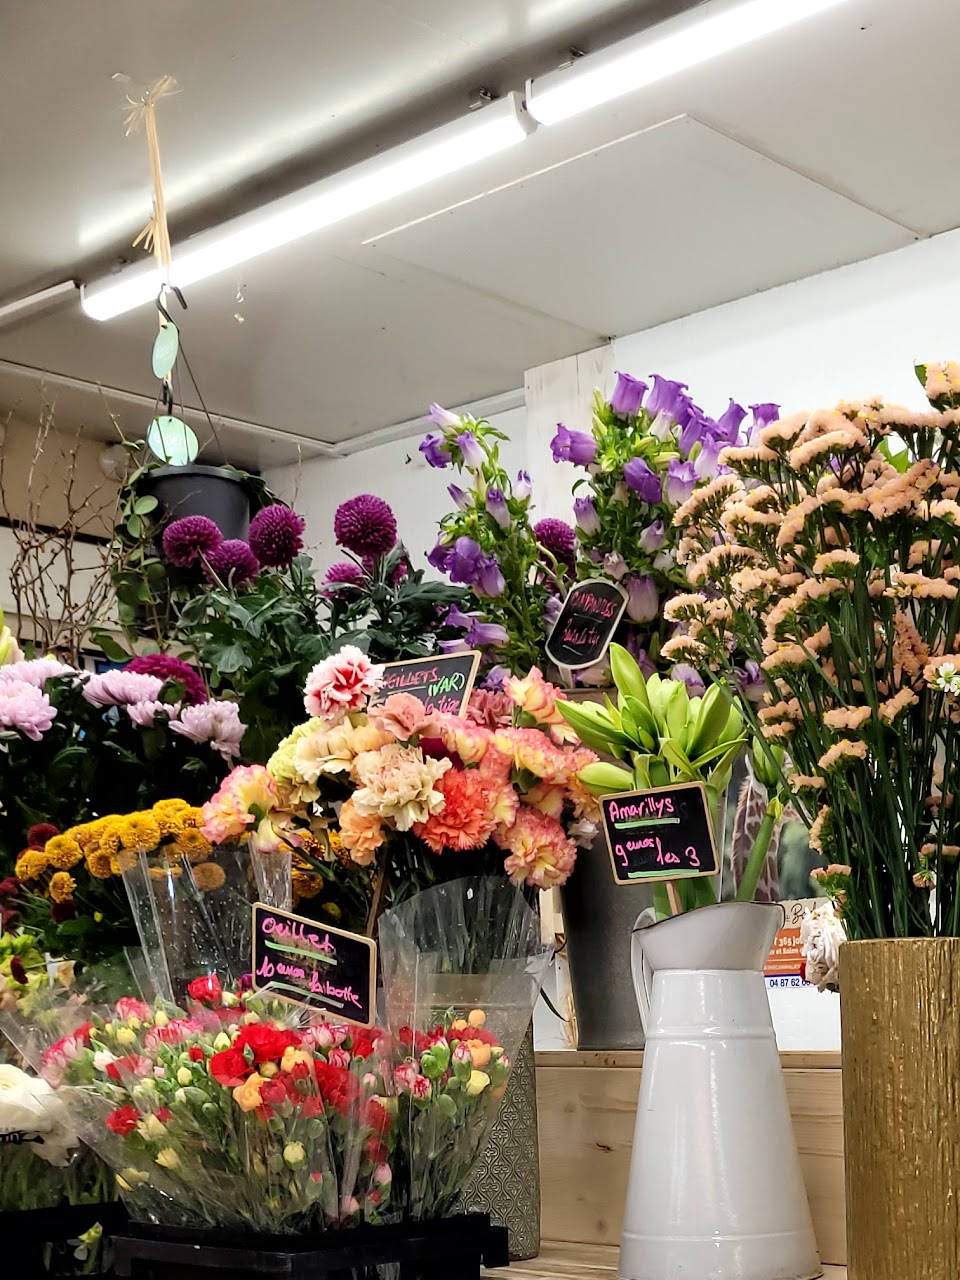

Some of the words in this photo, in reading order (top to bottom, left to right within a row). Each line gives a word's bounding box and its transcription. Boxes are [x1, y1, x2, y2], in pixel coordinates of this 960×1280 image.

[609, 796, 675, 823] Amarillys
[656, 836, 680, 865] les
[685, 846, 700, 867] 3
[779, 936, 792, 947] 365
[326, 980, 362, 1009] botte
[769, 979, 778, 987] 04
[780, 978, 789, 987] 87
[790, 978, 800, 987] 62
